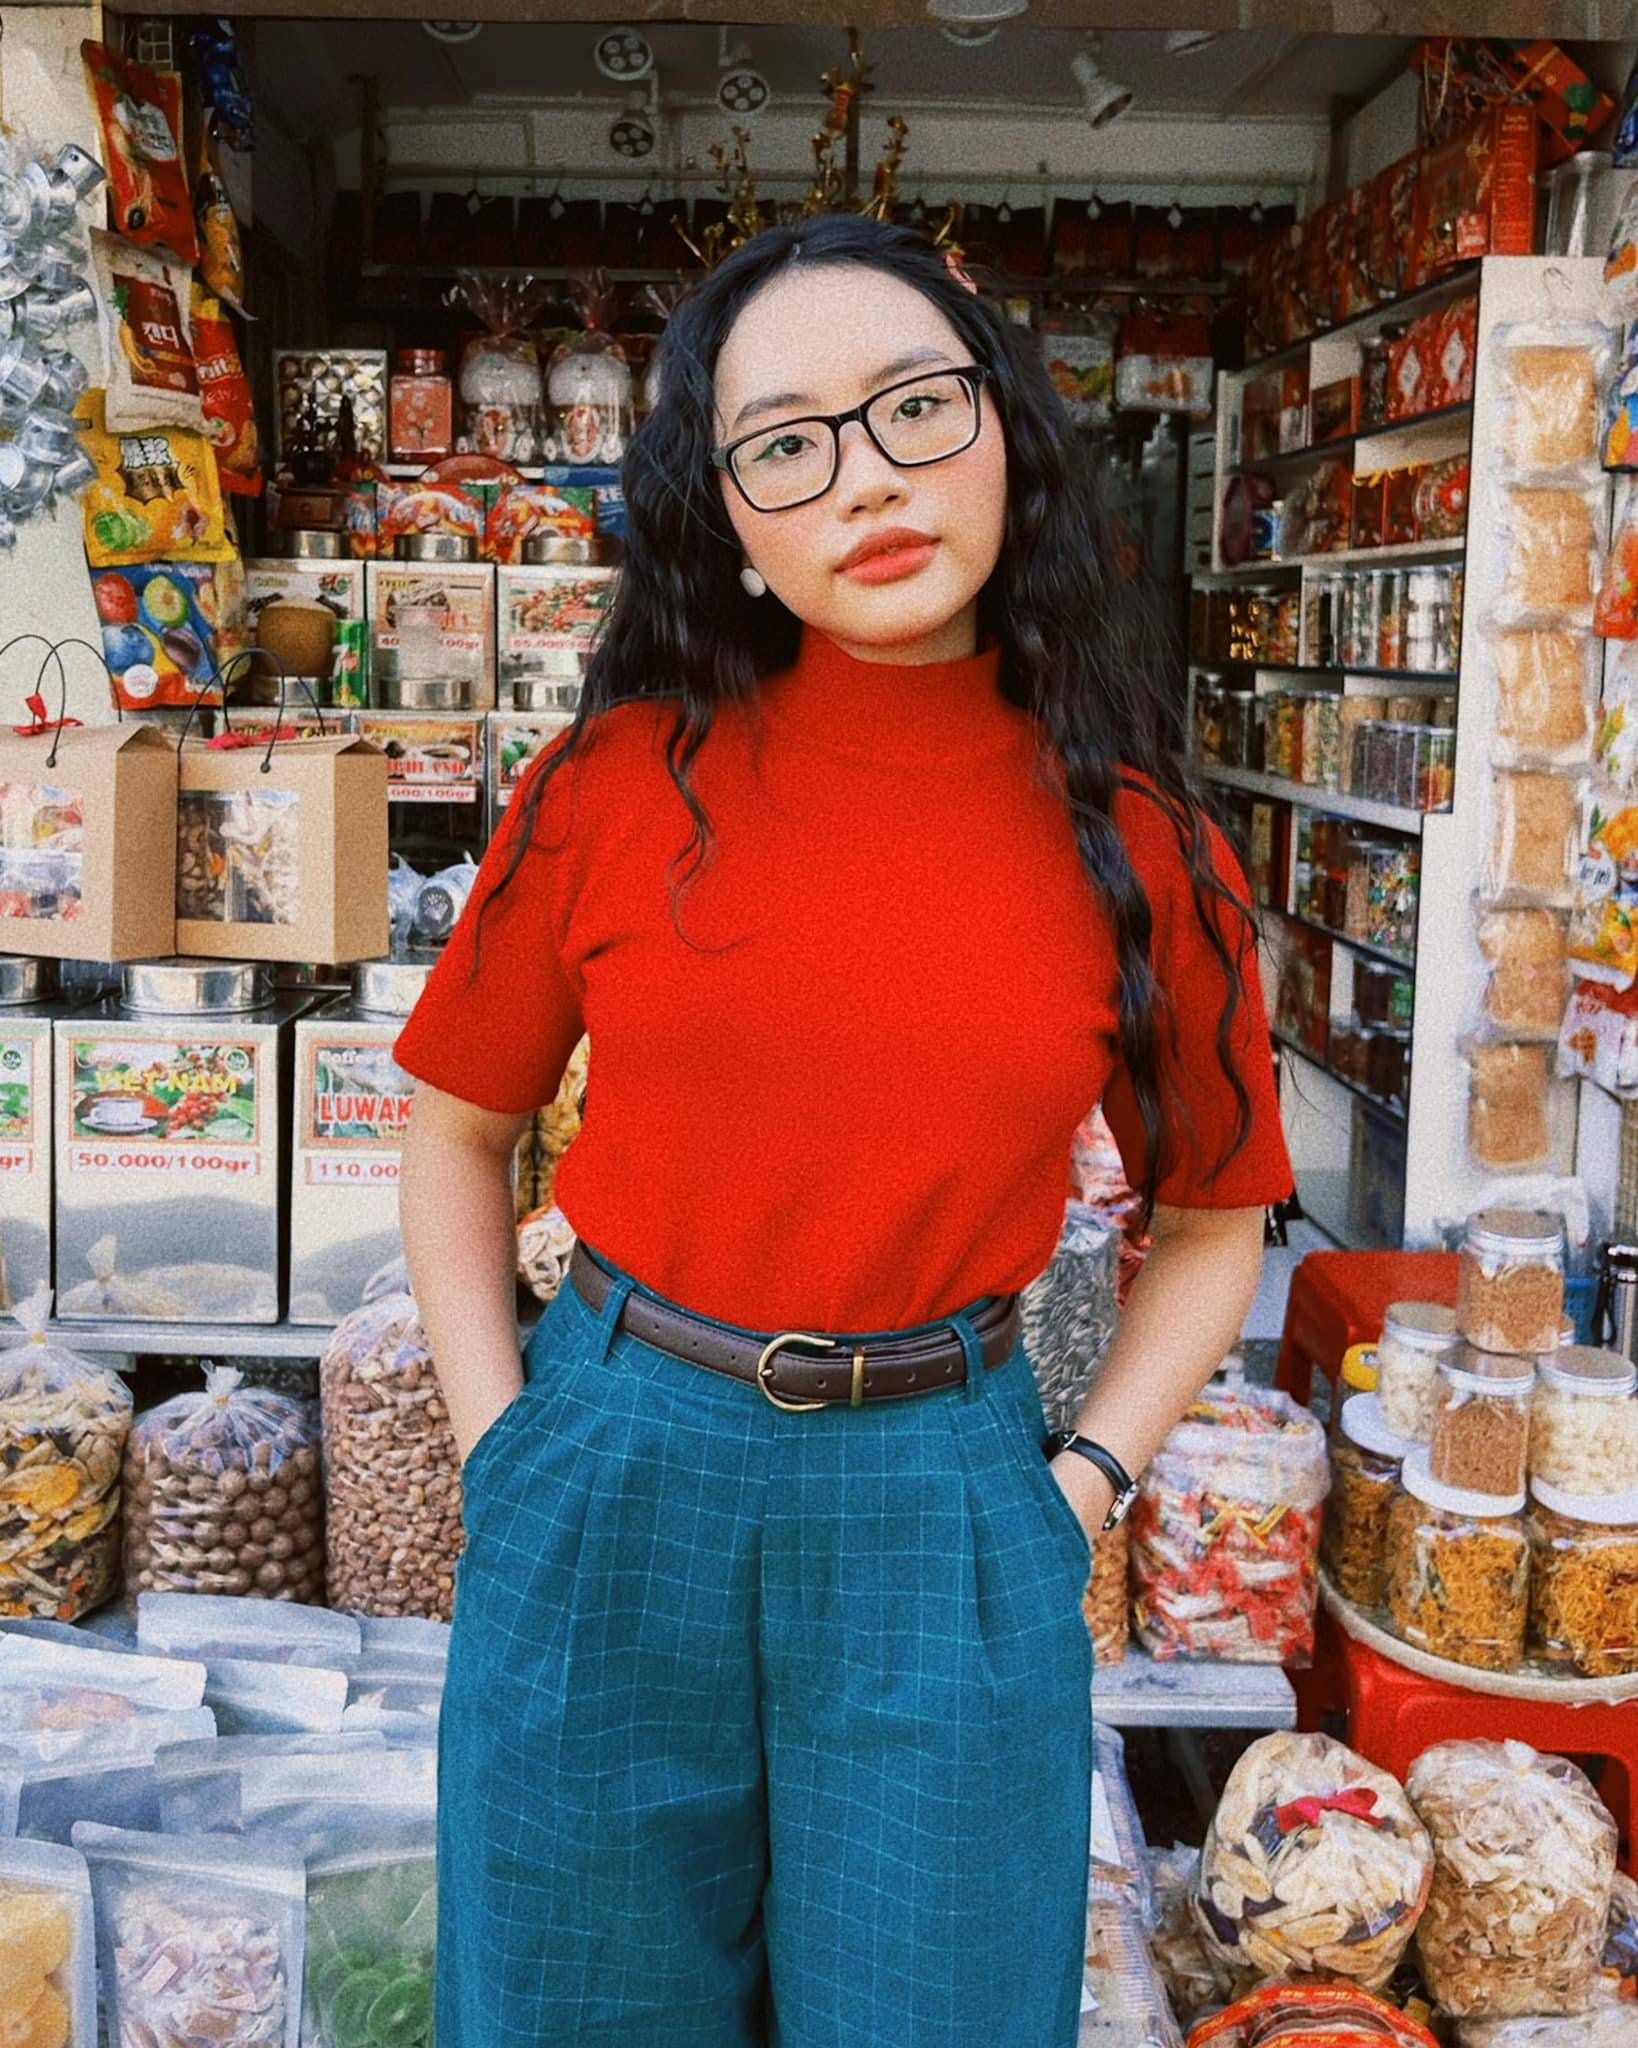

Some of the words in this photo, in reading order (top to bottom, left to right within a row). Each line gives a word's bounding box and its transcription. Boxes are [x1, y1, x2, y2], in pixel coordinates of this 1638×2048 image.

[320, 1095, 414, 1122] LUWAK
[78, 1152, 251, 1173] 50.000/100gr
[320, 1162, 398, 1178] 110.00
